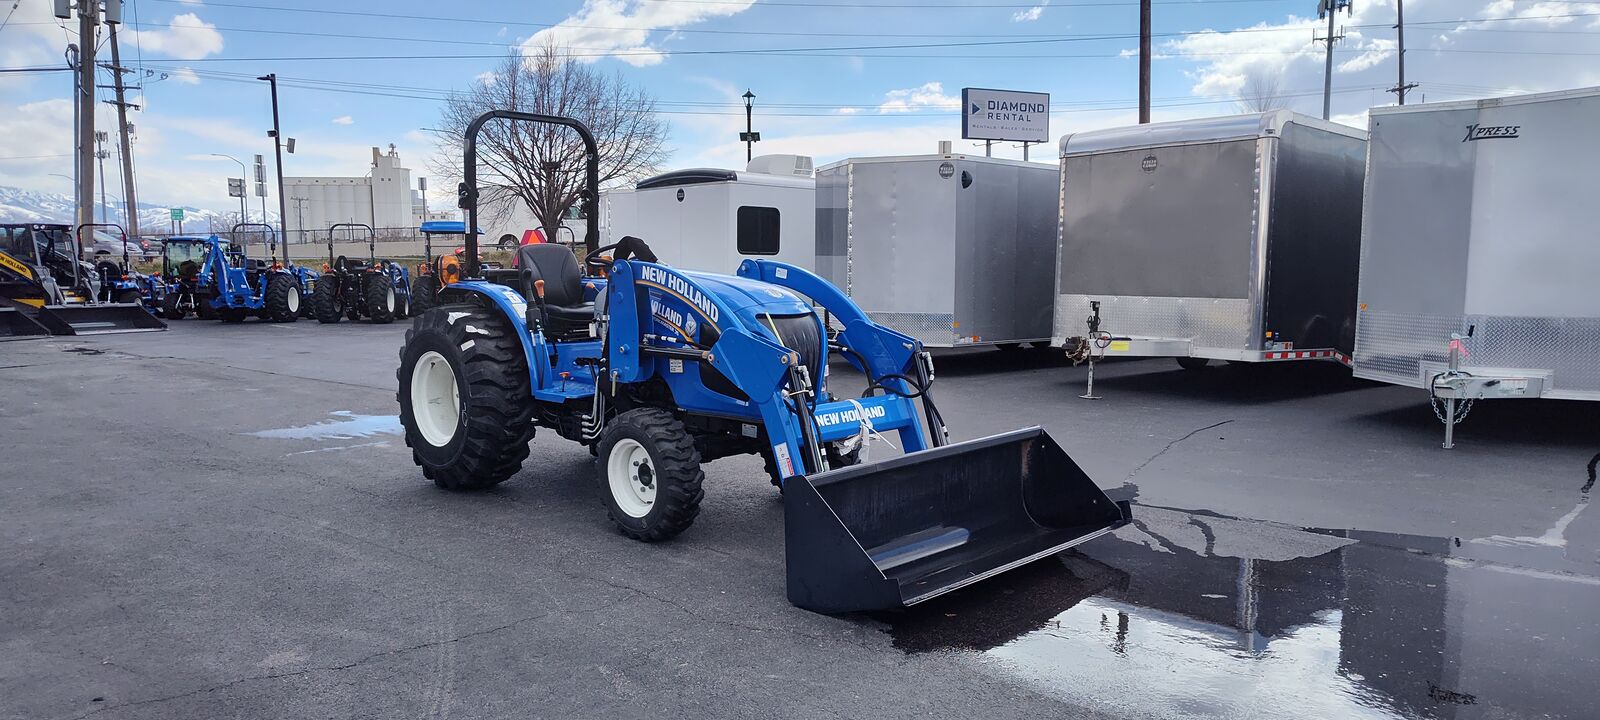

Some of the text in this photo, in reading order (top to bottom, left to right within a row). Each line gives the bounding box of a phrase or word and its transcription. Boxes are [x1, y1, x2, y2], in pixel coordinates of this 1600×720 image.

[988, 100, 1045, 113] DIAMOND
[987, 112, 1031, 122] RENTAL
[1462, 123, 1520, 142] XPRESS
[641, 265, 719, 323] NEW HOLLAND
[815, 412, 840, 427] NEW
